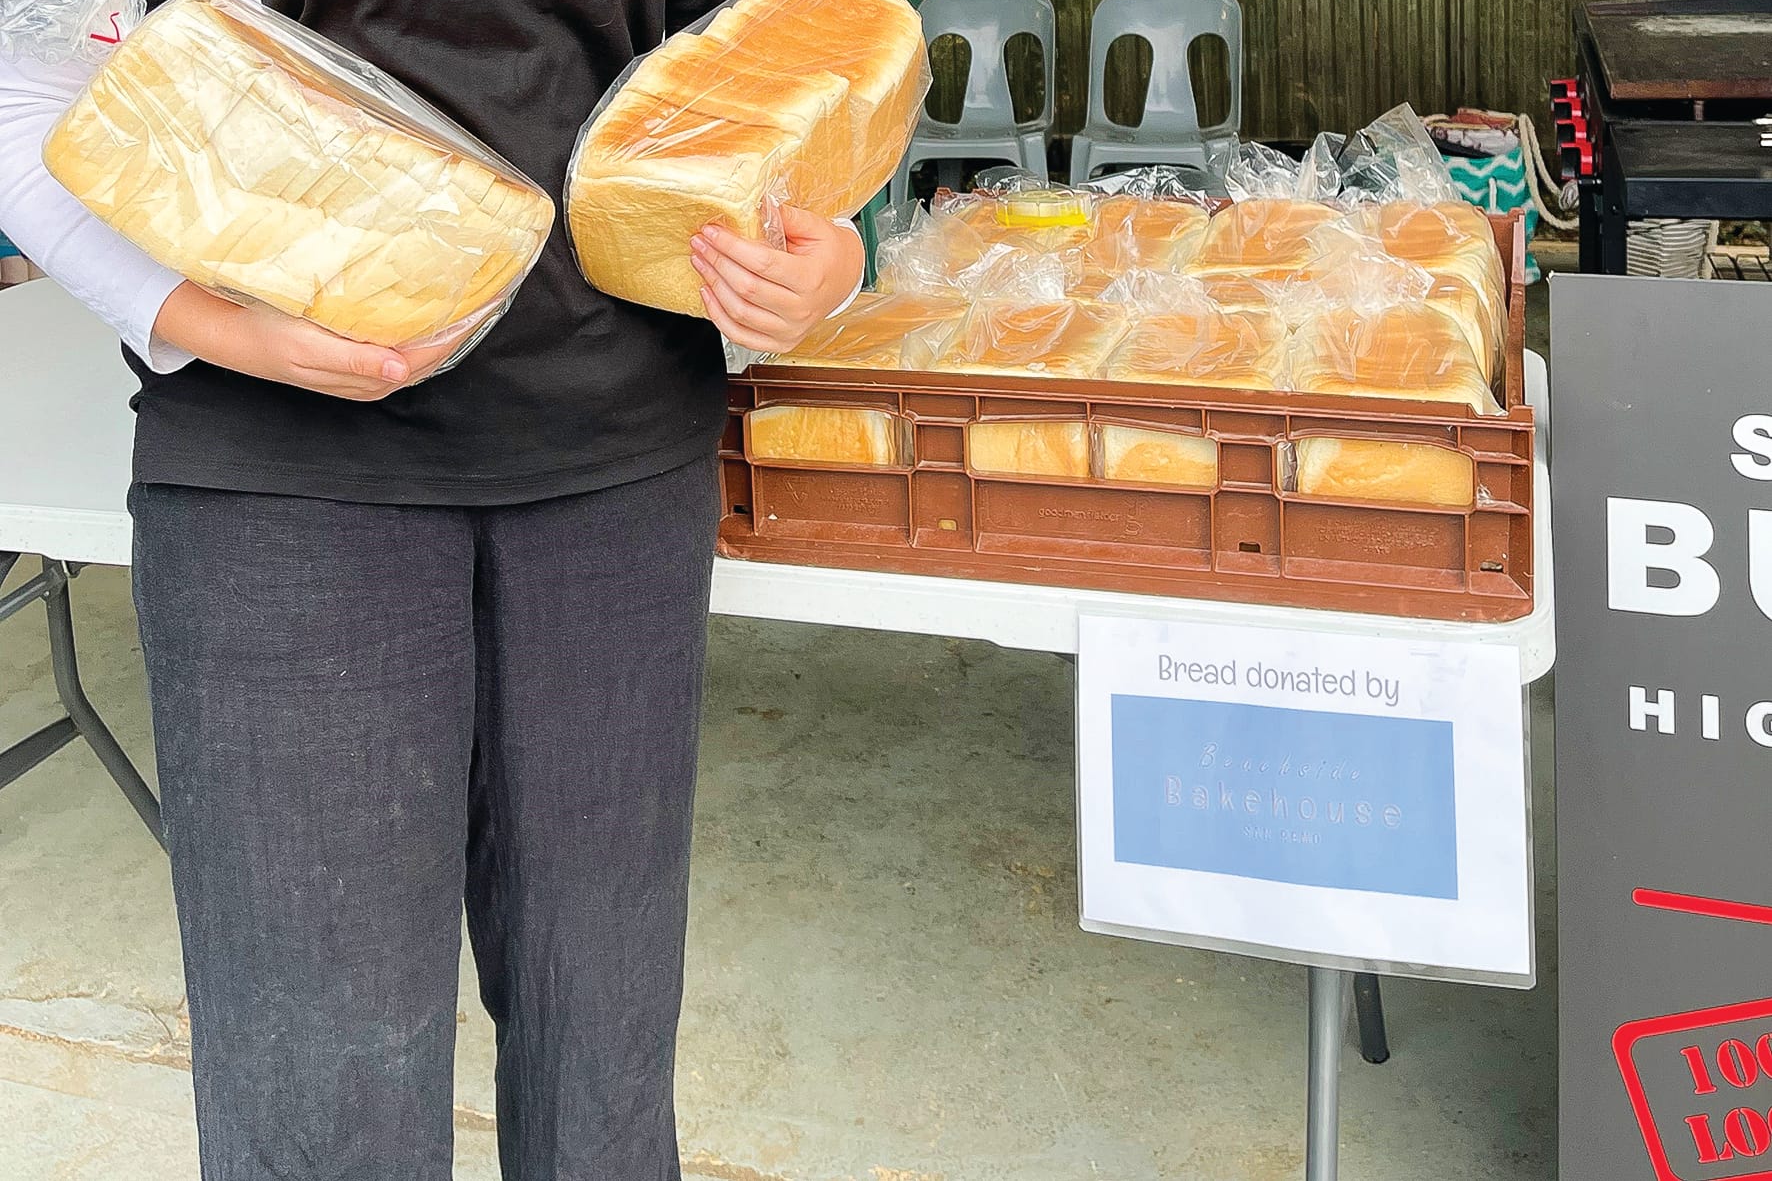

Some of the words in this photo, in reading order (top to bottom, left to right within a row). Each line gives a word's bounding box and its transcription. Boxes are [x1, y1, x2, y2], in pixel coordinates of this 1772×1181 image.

[1606, 497, 1772, 621] B
[1158, 654, 1237, 686] Bread
[1246, 661, 1356, 696] donated
[1366, 670, 1400, 707] by
[1165, 775, 1402, 827] Bakehouse
[1684, 1107, 1772, 1163] LO
